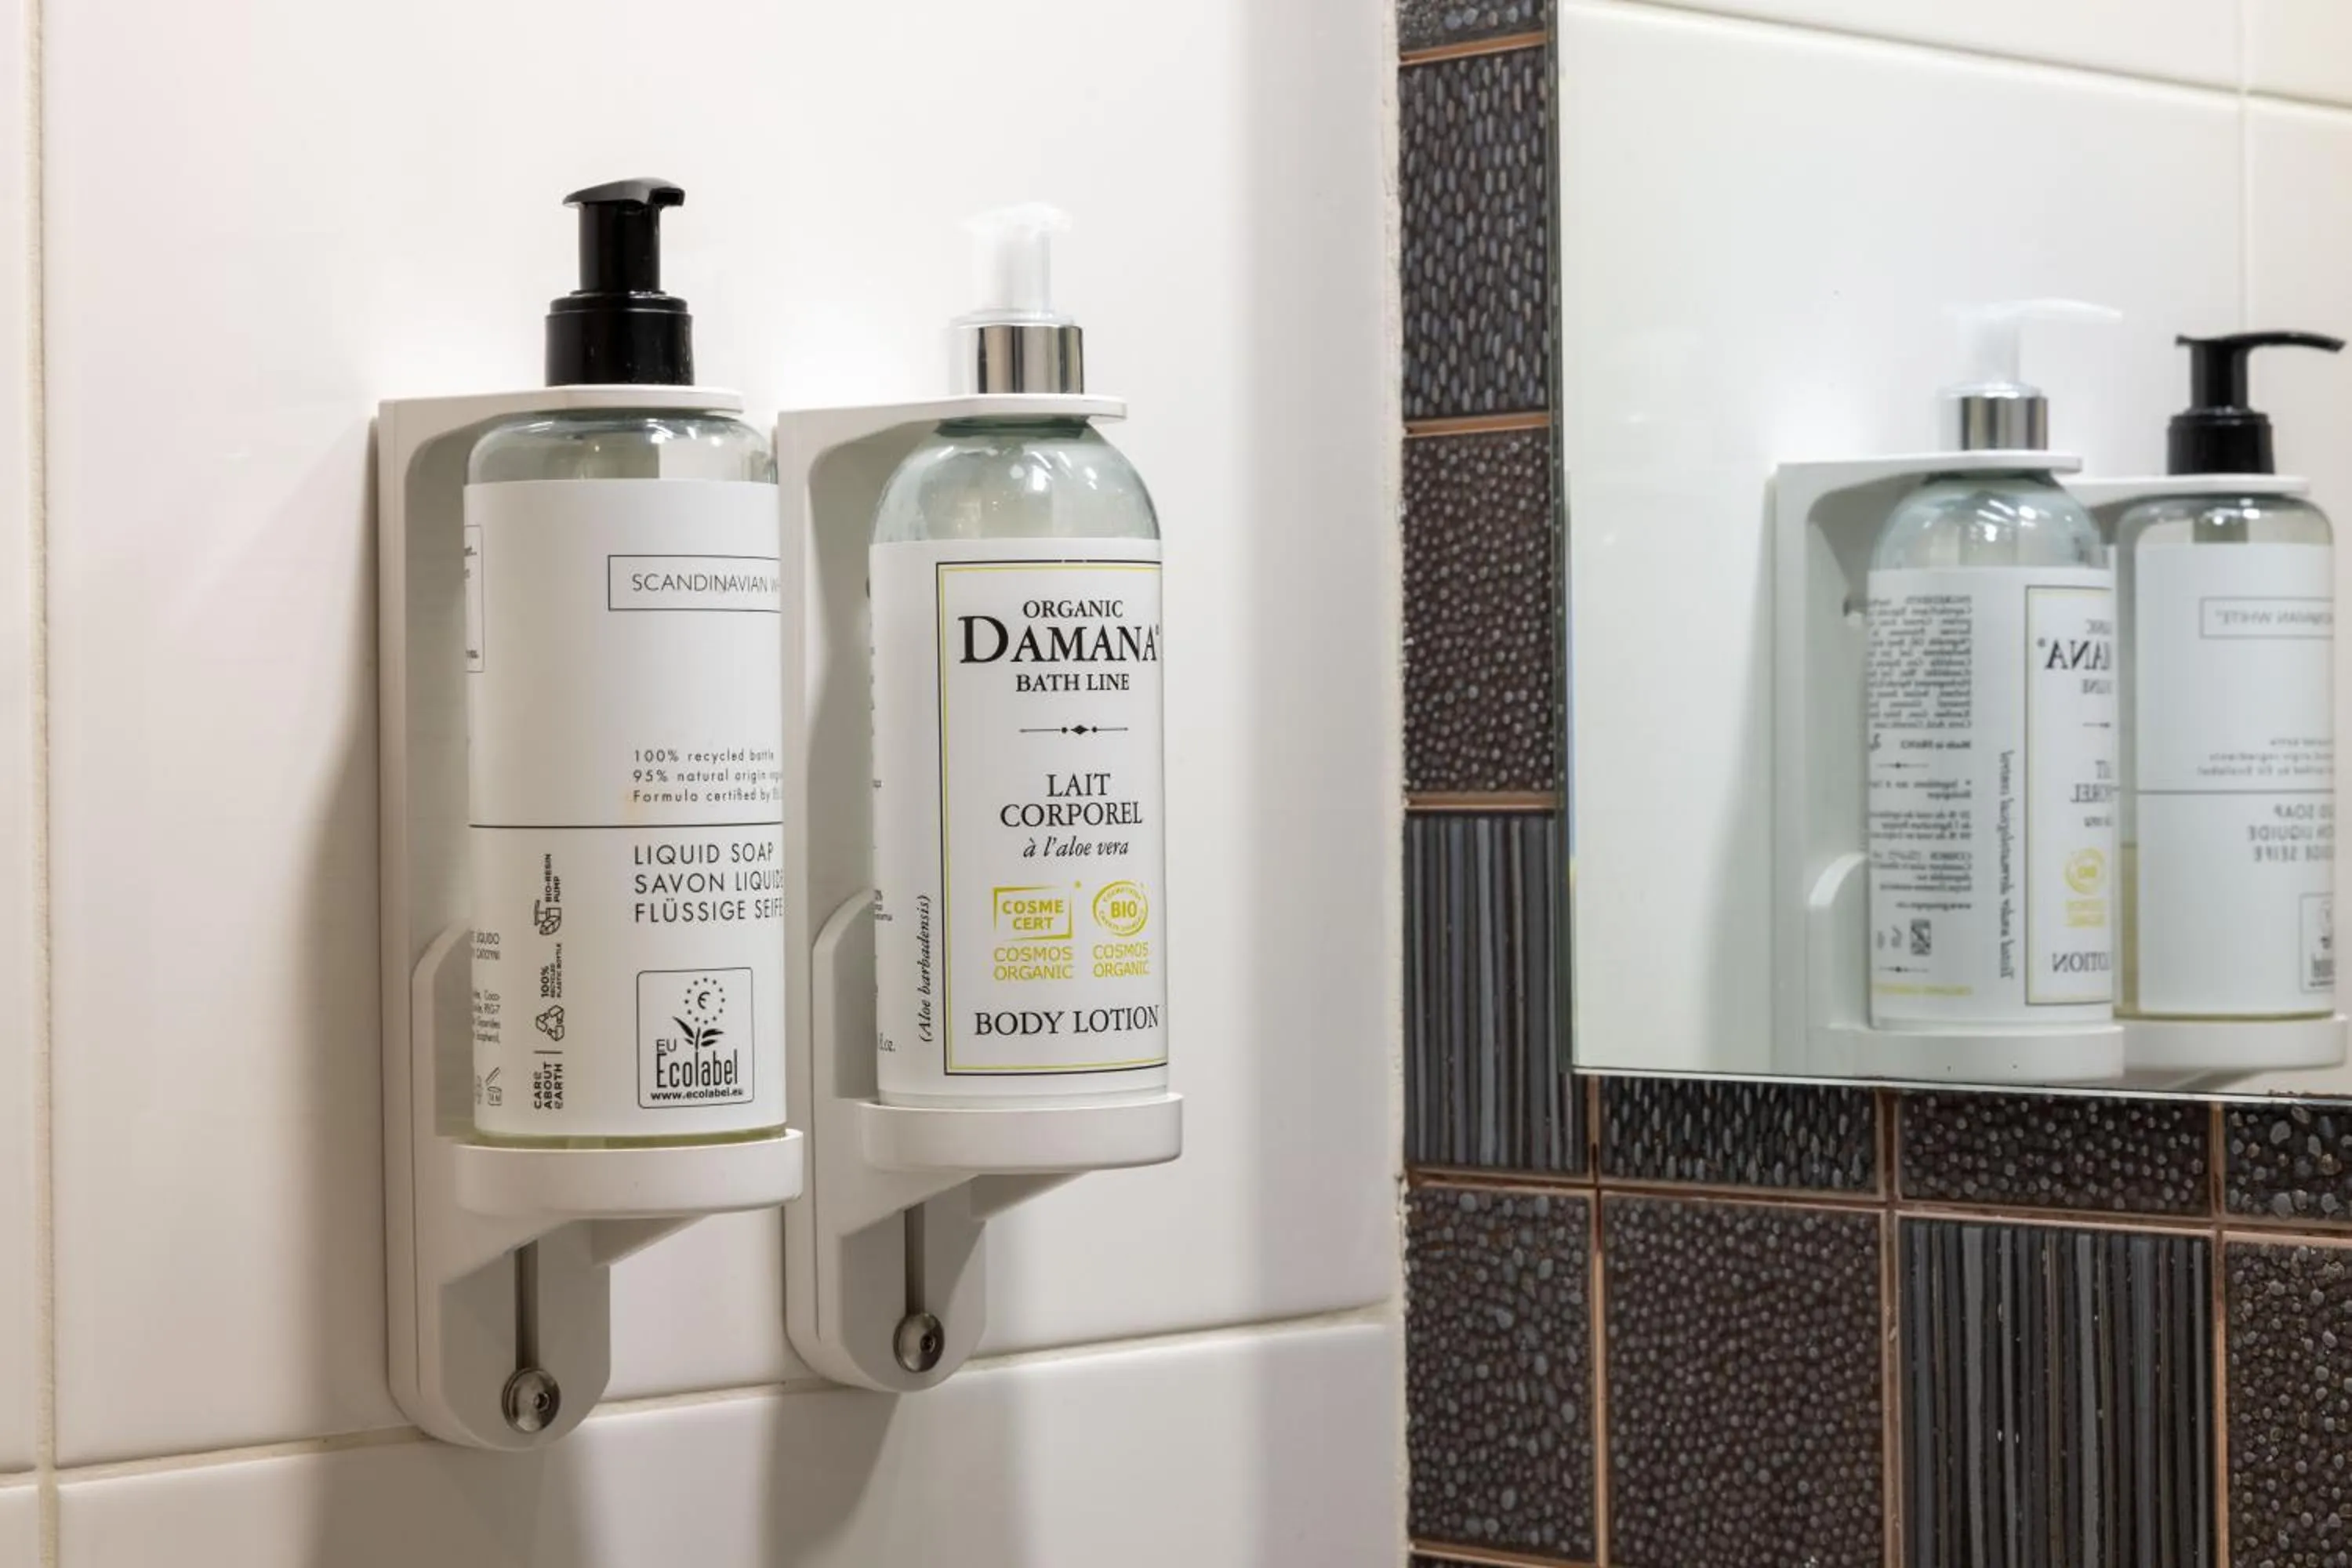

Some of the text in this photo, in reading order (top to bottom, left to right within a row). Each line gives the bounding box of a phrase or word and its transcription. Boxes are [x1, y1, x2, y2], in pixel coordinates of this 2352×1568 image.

[632, 573, 768, 592] SCANDINAVIAN
[1022, 600, 1123, 618] ORGANIC
[1015, 673, 1130, 691] BATH LINE
[634, 749, 679, 763] 100%
[688, 747, 744, 764] recycled
[633, 768, 668, 782] 95%
[677, 768, 728, 782] natural
[1047, 773, 1111, 797] LAIT
[633, 789, 699, 803] Formula
[706, 788, 756, 803] certified
[1000, 801, 1142, 827] CORPOREL
[634, 842, 773, 865] LIQUID SOAP
[1022, 836, 1129, 857] à l'aloe vera
[634, 873, 724, 894] SAVON
[635, 897, 746, 924] FLÜSSIGE
[1002, 899, 1064, 915] COSME
[1111, 901, 1138, 918] BIO
[1012, 916, 1054, 931] CERT
[993, 947, 1073, 962] COSMOS
[1093, 942, 1149, 959] COSMOS
[916, 895, 933, 1043] (Aloe barbadensis)
[993, 965, 1073, 981] ORGANIC
[1093, 961, 1150, 978] ORGANIC
[541, 966, 550, 998] 100%
[975, 1005, 1160, 1036] BODY LOTION
[656, 1040, 677, 1053] EU
[656, 1049, 738, 1089] Ecolabel
[544, 1062, 553, 1109] ABOUT
[554, 1063, 563, 1109] EARTH
[650, 1087, 743, 1100] www.ecolabel.eu
